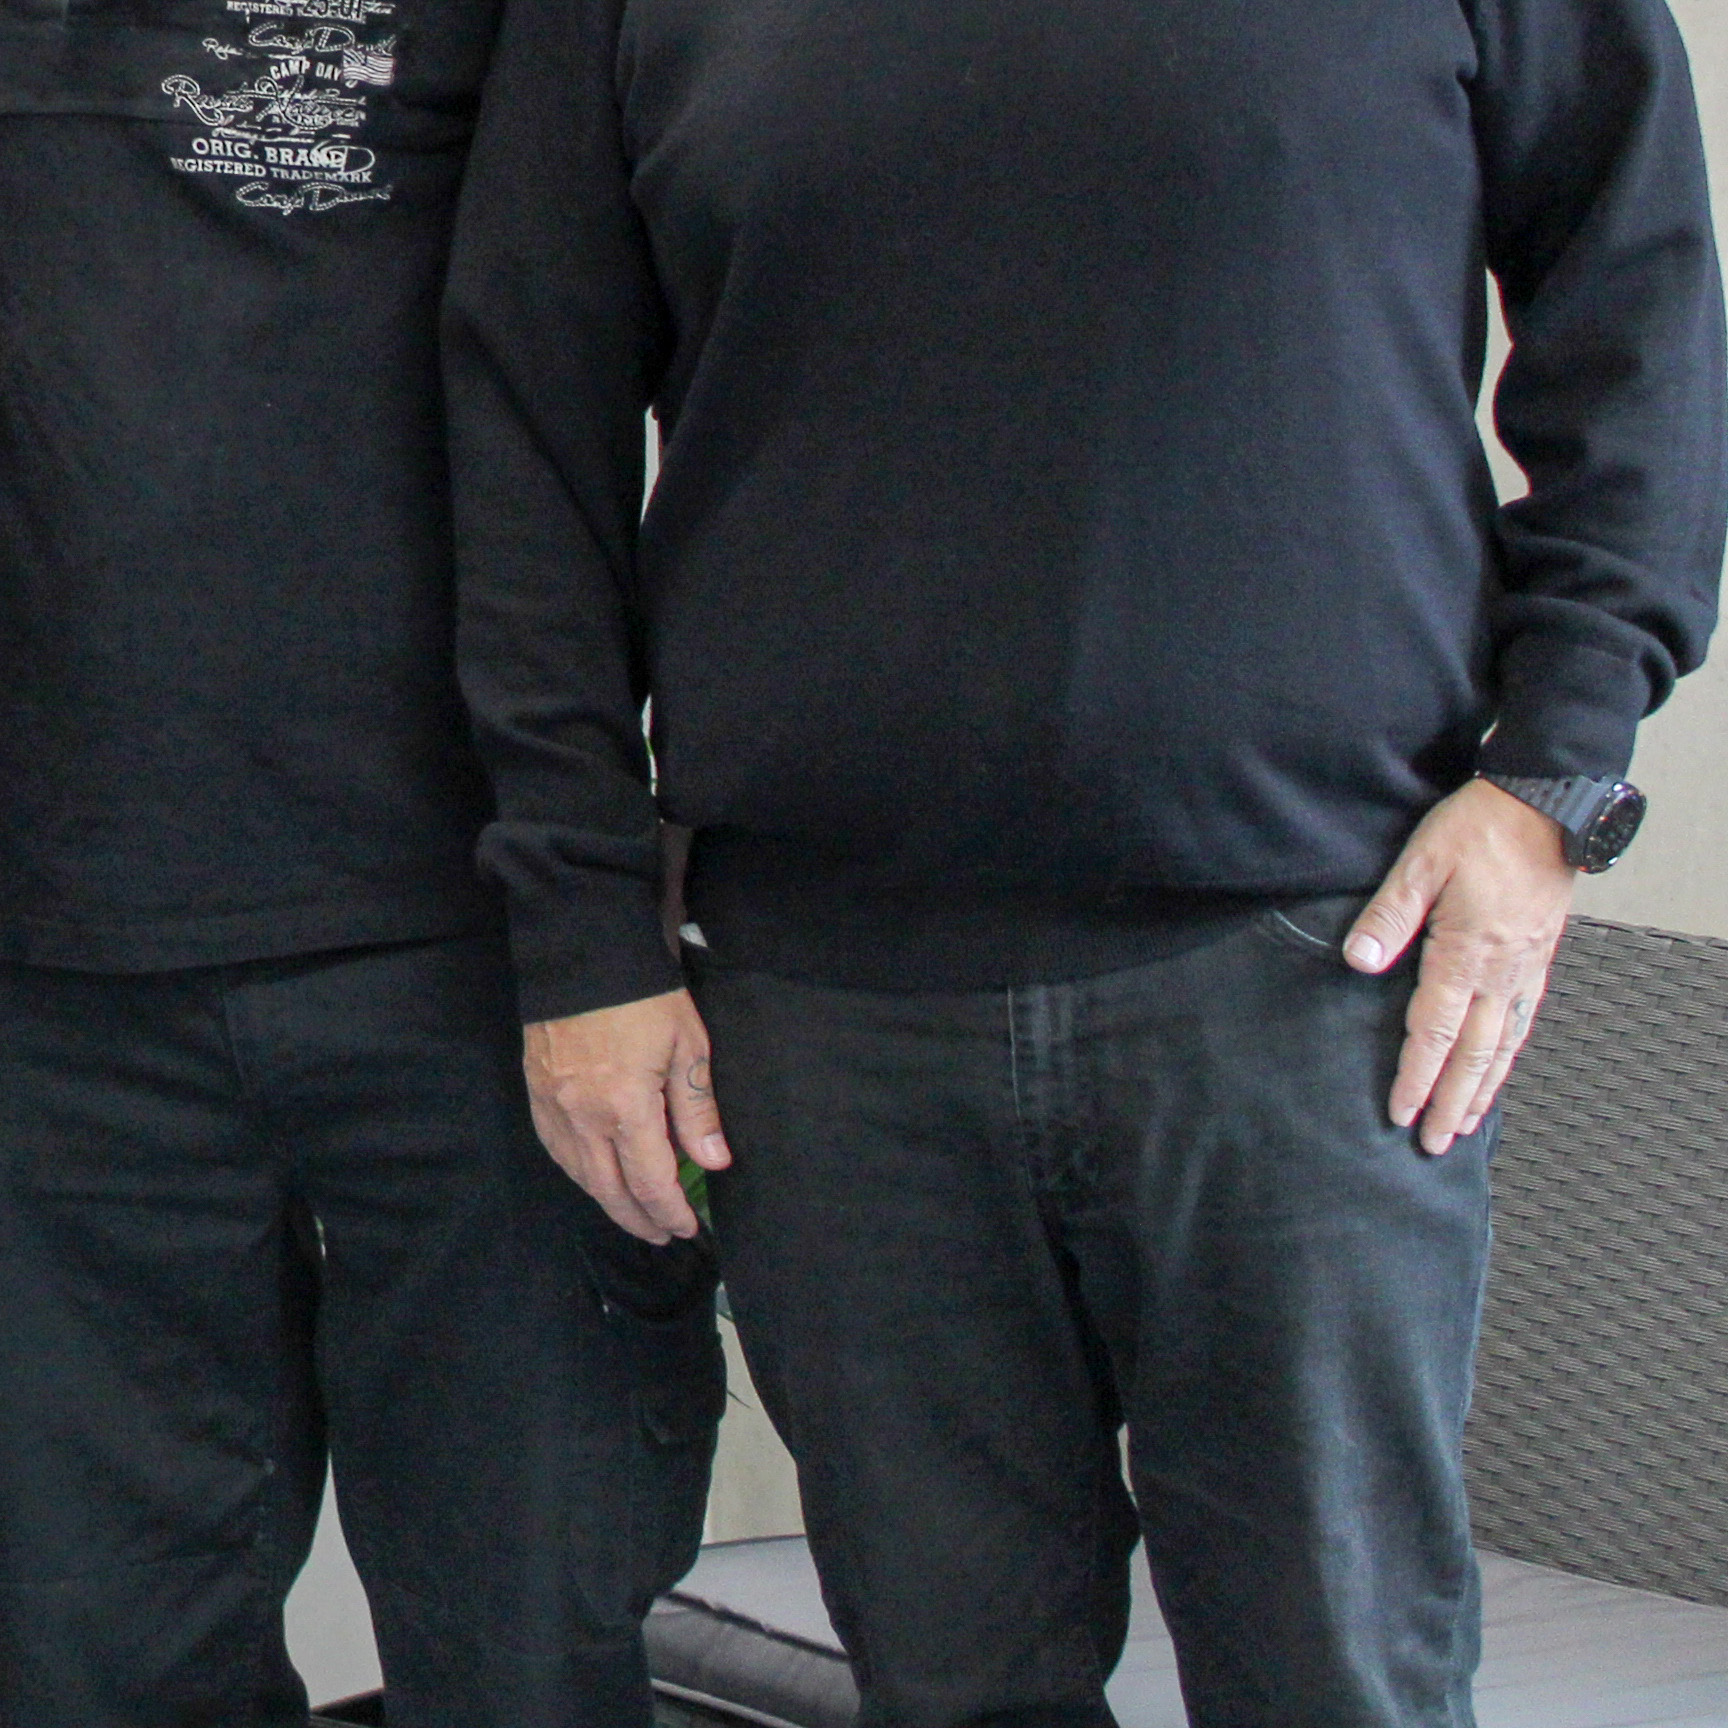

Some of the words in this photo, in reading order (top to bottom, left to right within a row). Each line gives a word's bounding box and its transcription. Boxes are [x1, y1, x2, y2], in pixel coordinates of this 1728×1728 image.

[269, 59, 310, 80] CAMP
[192, 138, 259, 160] ORIG.
[265, 146, 345, 168] BRAND
[170, 157, 267, 178] REGISTERED
[271, 167, 373, 184] TRADEMARK
